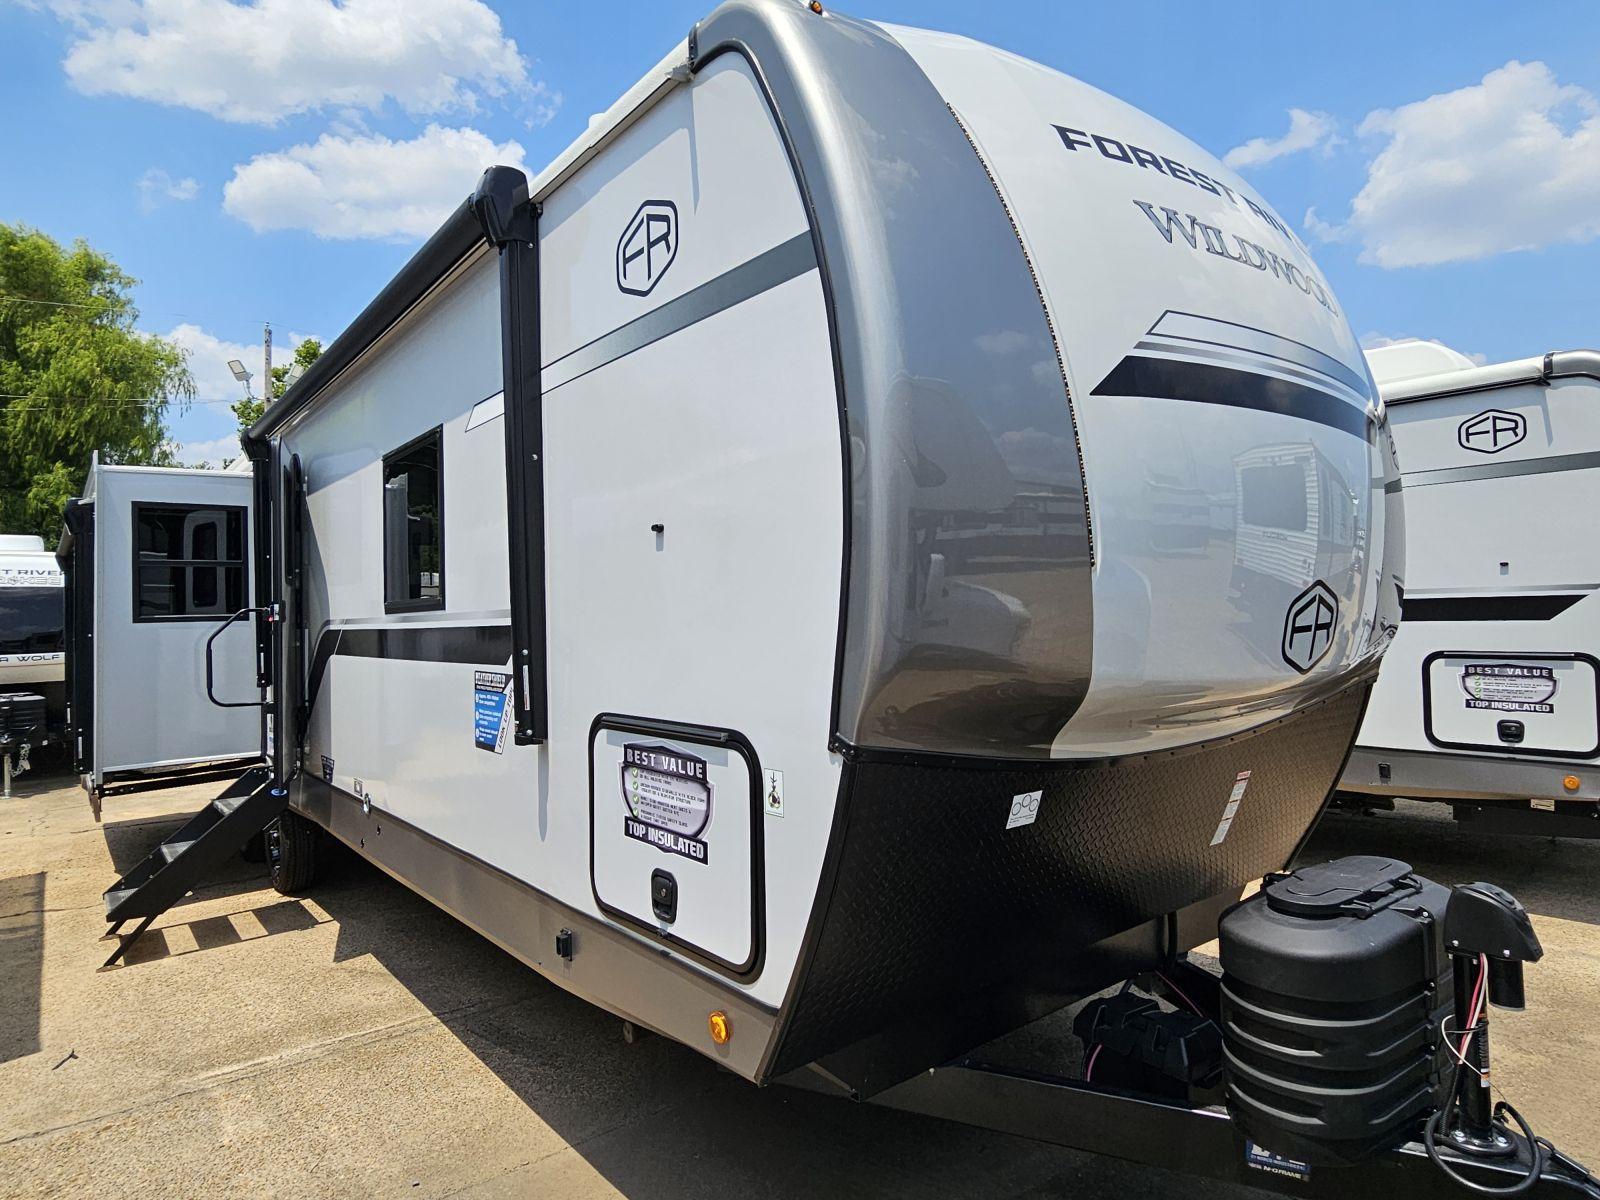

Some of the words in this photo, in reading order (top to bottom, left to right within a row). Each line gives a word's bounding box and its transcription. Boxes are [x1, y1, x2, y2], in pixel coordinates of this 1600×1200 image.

[1050, 123, 1238, 205] FOREST
[1465, 415, 1519, 447] FR
[1468, 666, 1500, 675] BEST
[1506, 668, 1550, 677] VALUE
[1468, 700, 1489, 708] TOP
[1491, 701, 1550, 712] INSULATED
[626, 748, 656, 767] BEST
[661, 756, 704, 779] VALUE
[627, 821, 646, 838] TOP
[647, 828, 704, 859] INSULATED
